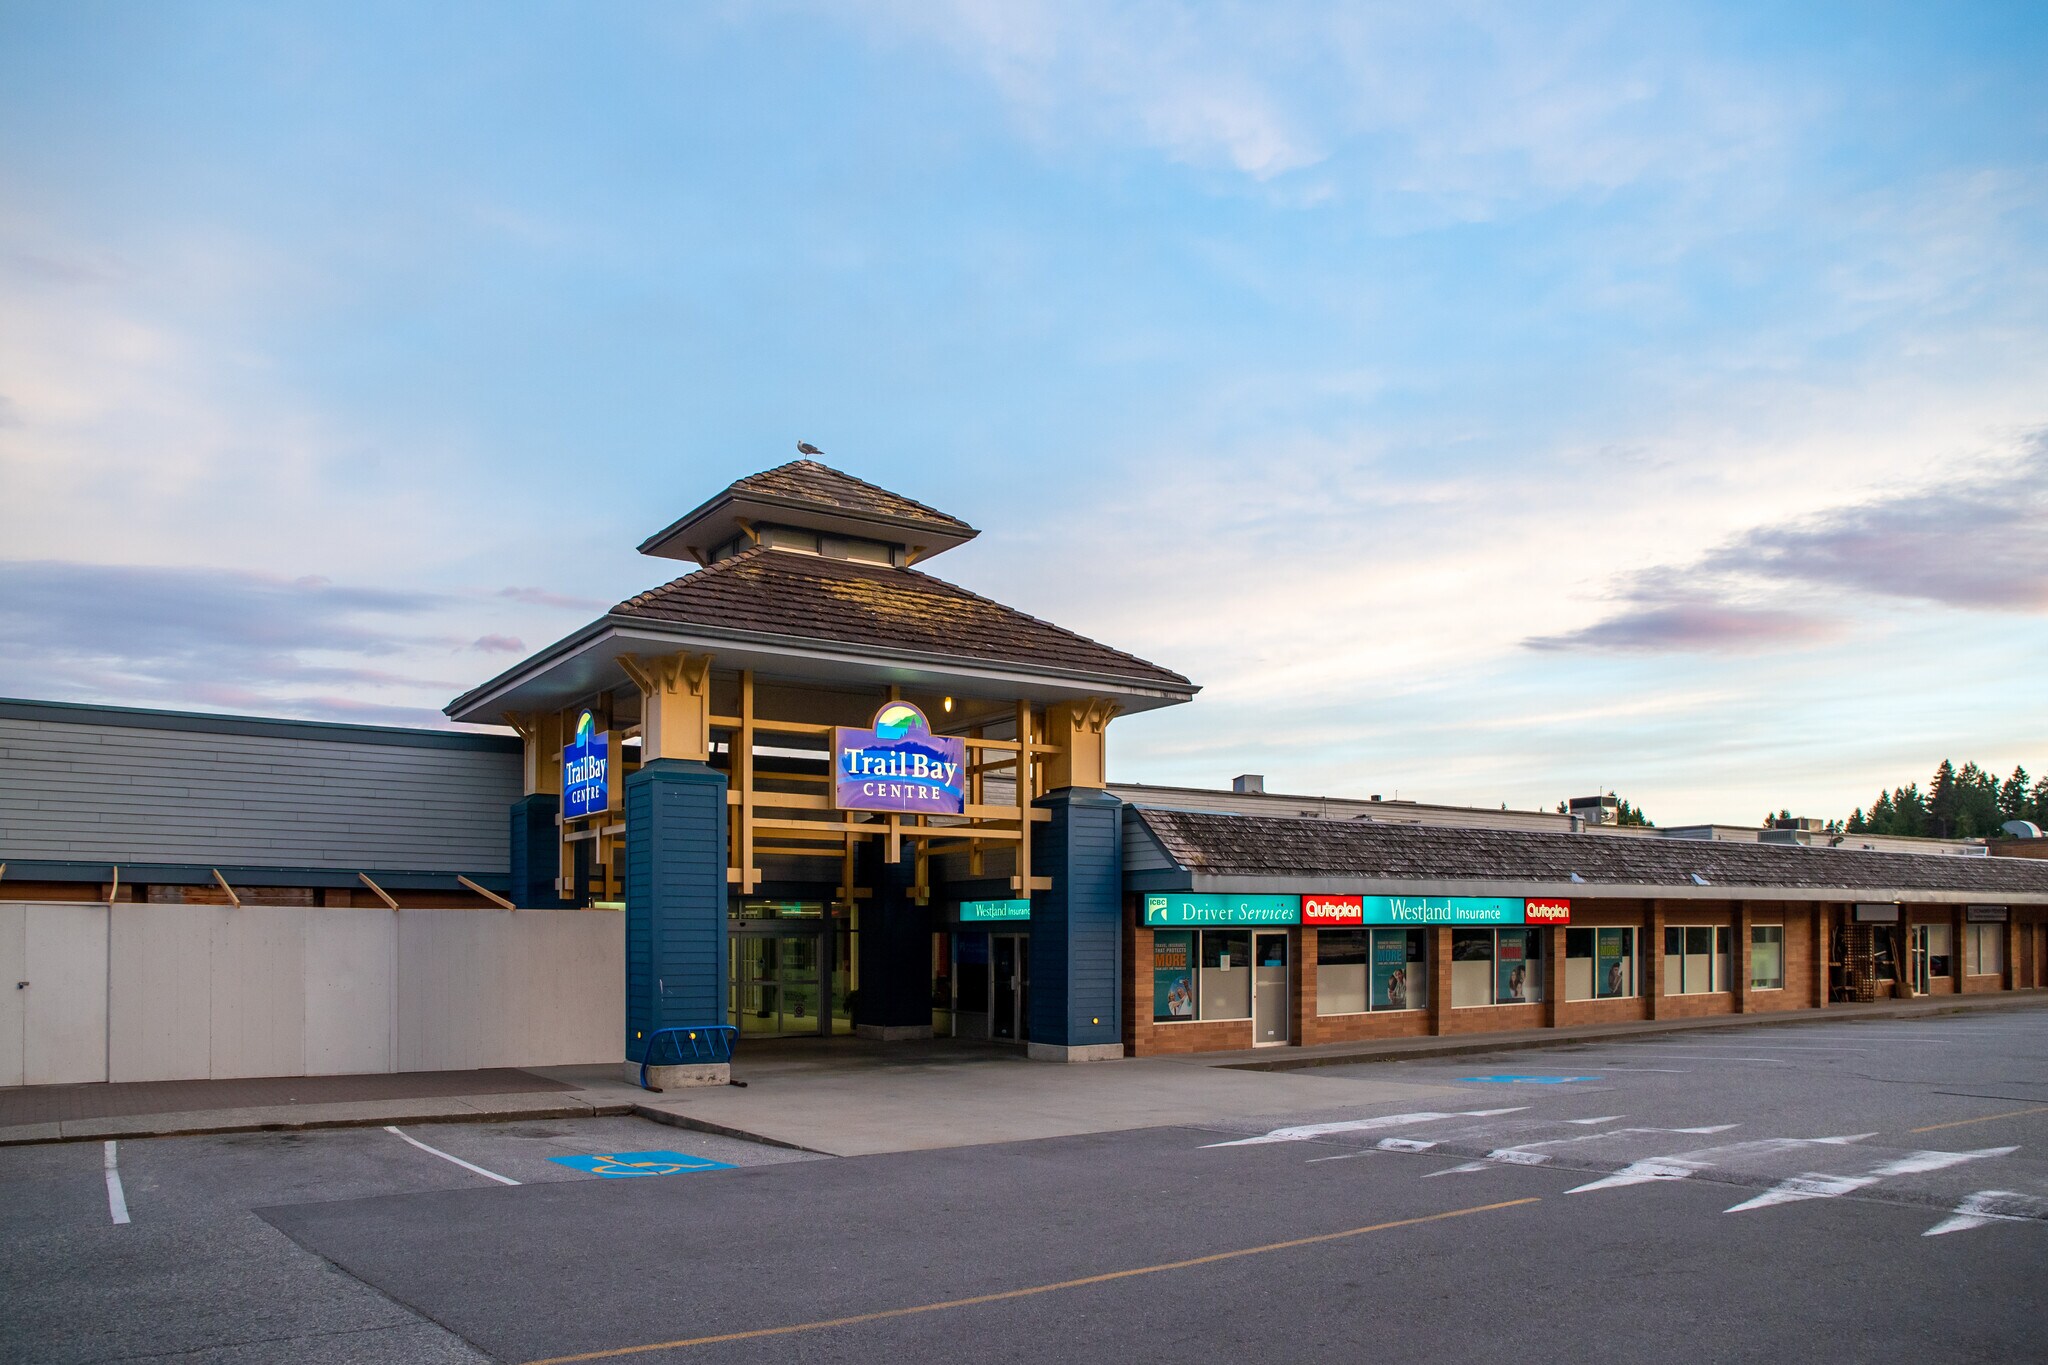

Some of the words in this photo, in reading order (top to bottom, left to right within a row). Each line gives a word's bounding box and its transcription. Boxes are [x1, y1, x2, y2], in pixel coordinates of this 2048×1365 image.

[566, 755, 588, 785] Trail
[588, 755, 607, 784] Bay
[844, 747, 907, 777] Trail
[911, 753, 958, 787] Bay
[572, 785, 599, 804] CENTRE
[863, 782, 941, 800] CENTRE
[975, 903, 1007, 918] Westland
[1008, 907, 1031, 916] Insuranc
[1182, 903, 1234, 921] Driver
[1238, 903, 1295, 921] Services
[1389, 898, 1451, 923] Westland
[1456, 906, 1501, 920] Insurance
[1377, 950, 1402, 962] MORE
[1600, 945, 1620, 956] MORE
[1155, 953, 1186, 967] MORE
